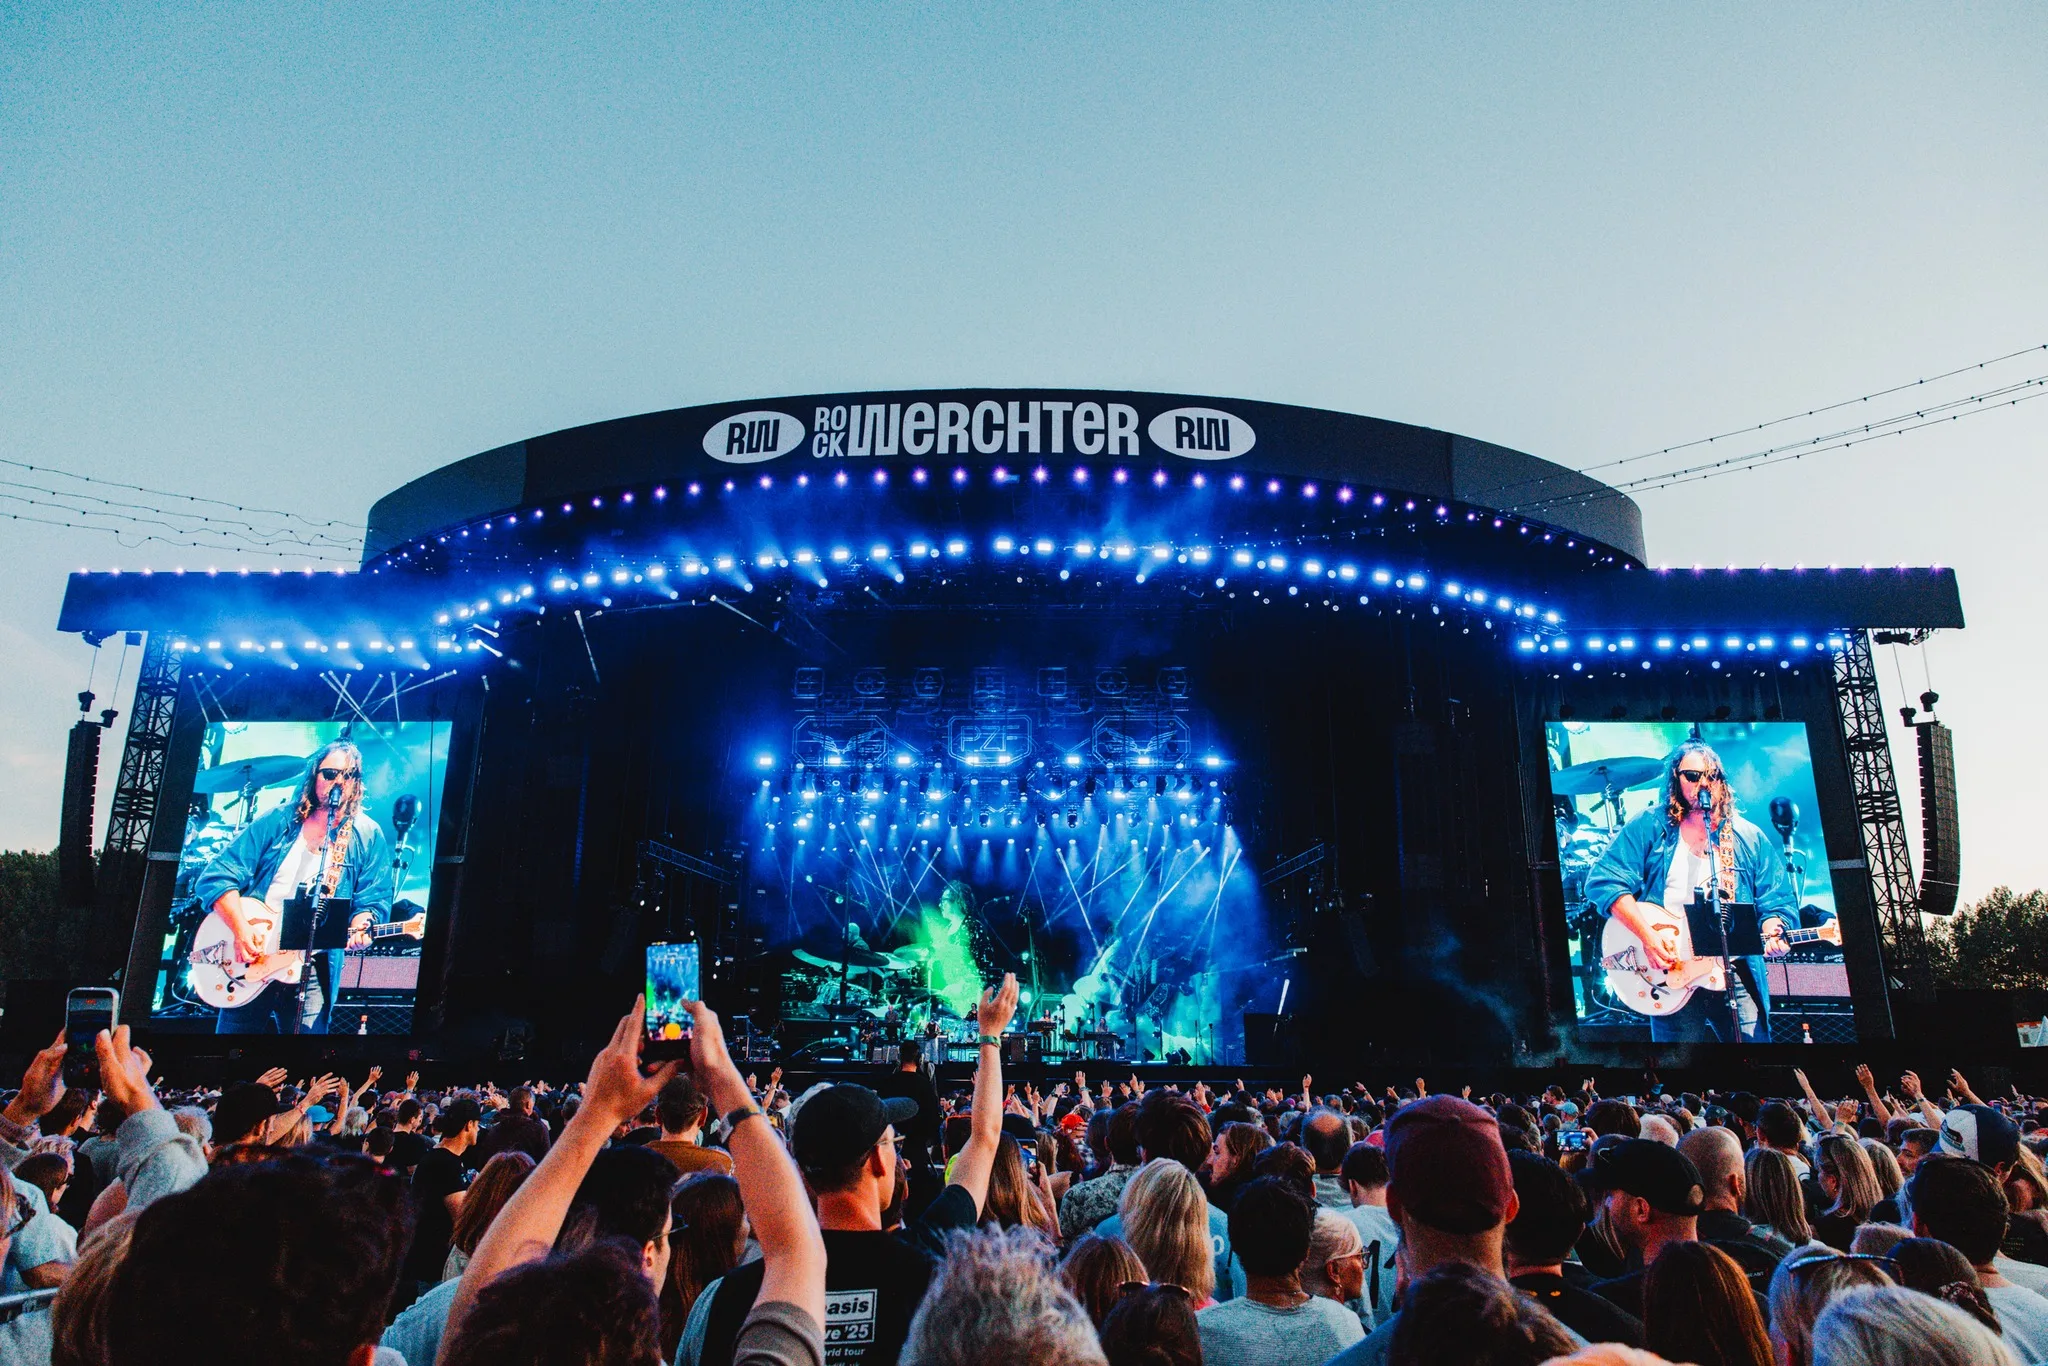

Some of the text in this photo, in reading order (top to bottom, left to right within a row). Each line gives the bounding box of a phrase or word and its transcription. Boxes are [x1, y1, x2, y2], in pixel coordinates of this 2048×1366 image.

[726, 419, 781, 456] RW
[1175, 415, 1231, 452] RW
[961, 725, 1020, 752] PZF
[825, 1297, 869, 1315] asis
[844, 1324, 869, 1339] '25
[844, 1347, 866, 1356] tour
